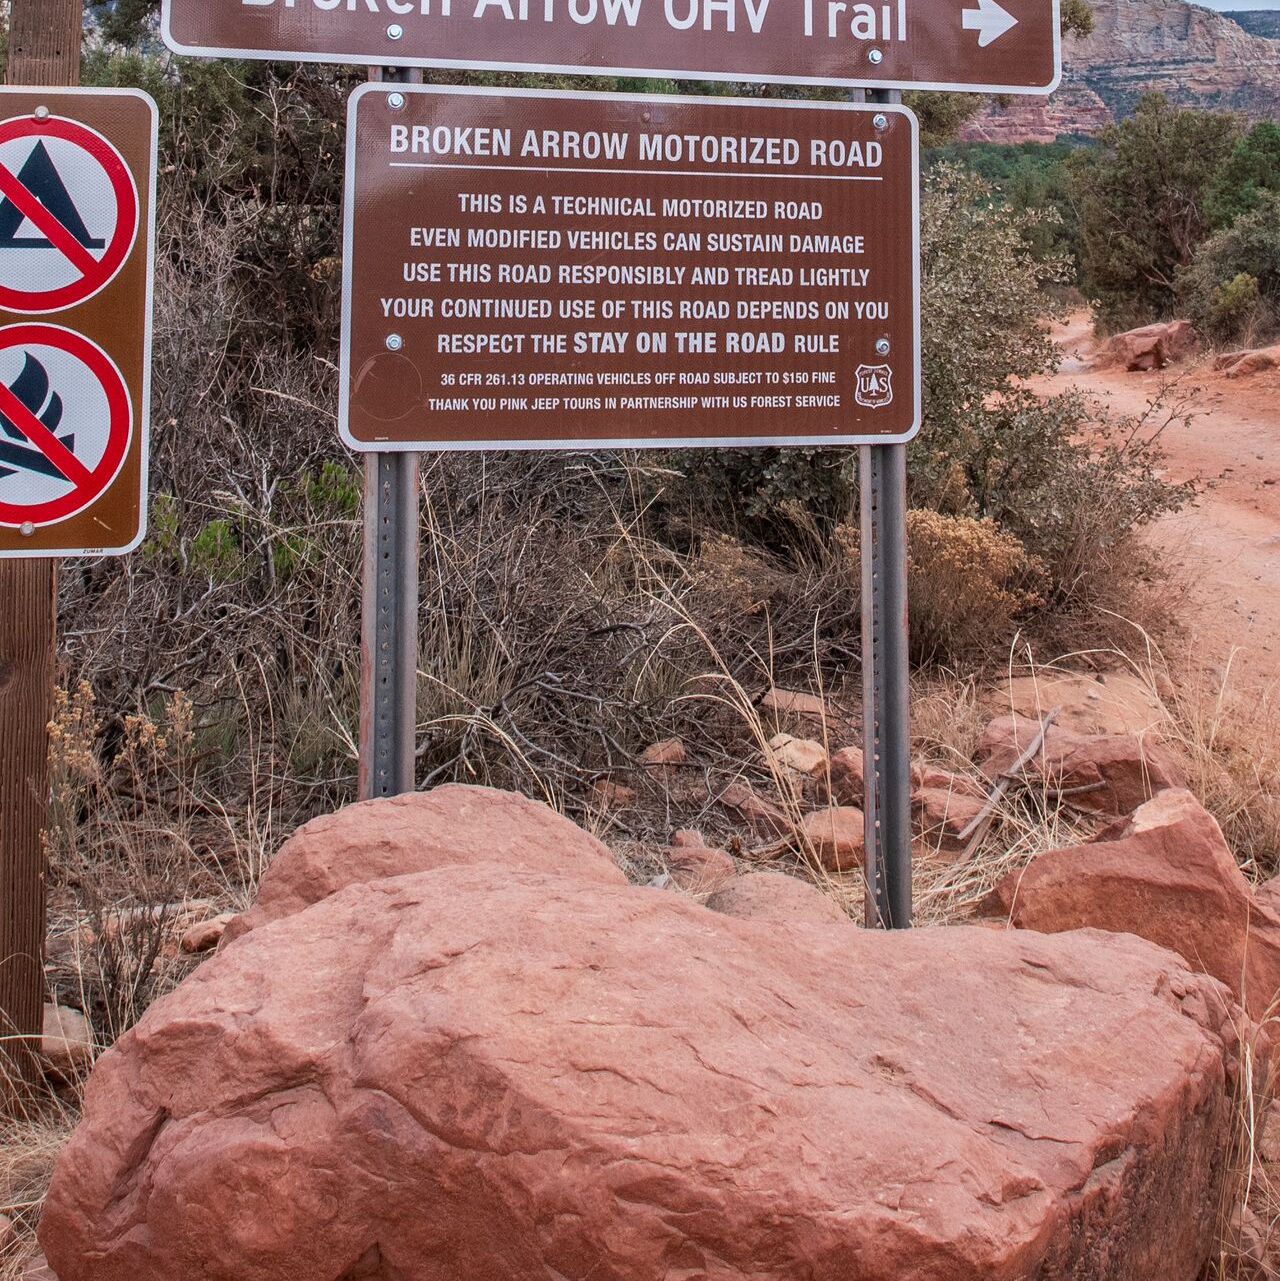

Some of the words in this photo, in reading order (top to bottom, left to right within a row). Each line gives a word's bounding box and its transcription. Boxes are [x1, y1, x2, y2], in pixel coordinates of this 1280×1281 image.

[388, 124, 511, 156] BROKEN
[520, 129, 629, 160] ARROW
[639, 133, 800, 165] MOTORIZED
[810, 139, 883, 167] ROAD
[457, 193, 502, 213] THIS
[509, 194, 528, 214] IS
[532, 195, 546, 214] A
[551, 195, 657, 217] TECHNICAL
[662, 198, 768, 219] MOTORIZED
[774, 201, 823, 220] ROAD
[410, 227, 460, 247] EVEN
[467, 228, 562, 249] MODIFIED
[566, 230, 657, 251] VEHICLES
[663, 232, 701, 251] CAN
[707, 233, 783, 253] SUSTAIN
[789, 234, 865, 254] DAMAGE
[403, 262, 441, 282] USE
[446, 263, 492, 283] THIS
[498, 264, 552, 284] ROAD
[558, 265, 686, 285] RESPONSIBLY
[690, 266, 729, 286] AND
[734, 267, 794, 286] TREAD
[800, 268, 870, 287] LIGHTLY
[380, 297, 434, 318] YOUR
[441, 298, 552, 319] CONTINUED
[559, 299, 596, 319] USE
[601, 299, 626, 319] OF
[630, 300, 674, 319] THIS
[679, 300, 730, 319] ROAD
[737, 300, 820, 320] DEPENDS
[825, 301, 849, 320] ON
[854, 301, 889, 320] YOU
[437, 333, 526, 354] RESPECT
[530, 334, 567, 354] THE
[573, 331, 630, 354] STAY
[636, 331, 667, 354] ON
[674, 332, 717, 353] THE
[725, 332, 786, 354] ROAD
[794, 334, 840, 353] RULE
[440, 373, 457, 386] 36
[459, 373, 482, 386] CFR
[485, 373, 525, 386] 261.13
[528, 372, 594, 386] OPERATING
[596, 372, 652, 385] VEHICLES
[654, 372, 676, 385] OFF
[679, 372, 710, 385] ROAD
[713, 372, 763, 385] SUBJECT
[765, 372, 780, 384] TO
[782, 372, 809, 385] $150
[811, 371, 836, 384] FINE
[428, 398, 469, 411] THANK
[472, 398, 496, 411] YOU
[499, 397, 528, 410] PINK
[530, 397, 560, 410] JEEP
[562, 397, 601, 410] TOURS
[604, 397, 617, 410] IN
[620, 396, 699, 409] PARTNERSHIP
[700, 396, 730, 409] WITH
[732, 396, 748, 408] US
[750, 395, 793, 408] FOREST
[795, 395, 841, 408] SERVICE
